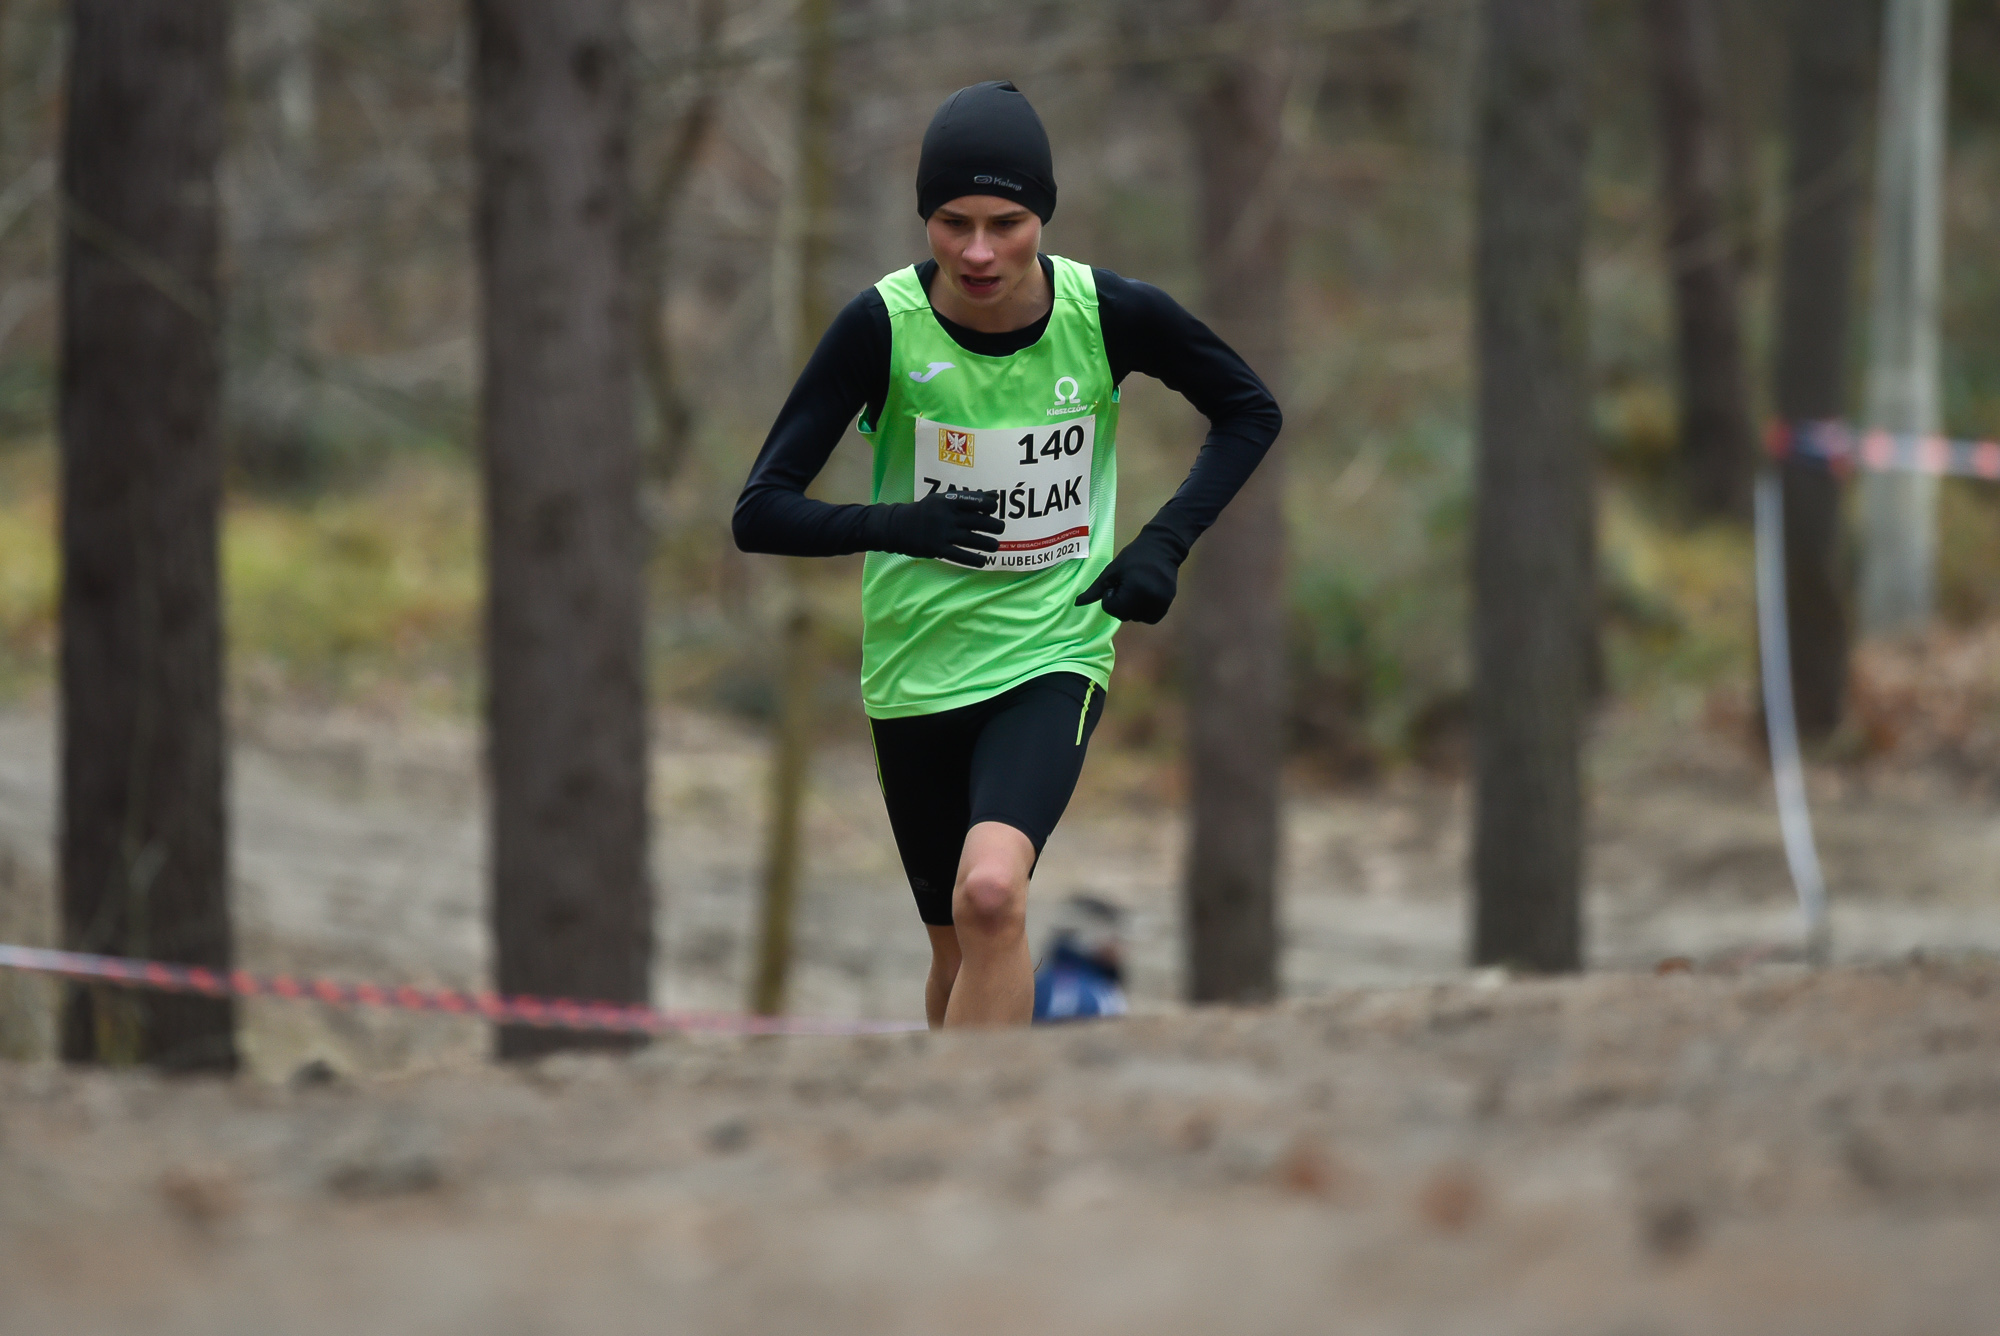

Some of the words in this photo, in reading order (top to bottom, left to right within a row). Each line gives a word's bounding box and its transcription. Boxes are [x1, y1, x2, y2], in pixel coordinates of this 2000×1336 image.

[1046, 404, 1088, 416] Kleszczów
[1018, 425, 1084, 465] 140
[923, 475, 1083, 520] ZIŚLAK
[1001, 551, 1053, 567] LUBELSKI
[1056, 542, 1080, 559] 2021
